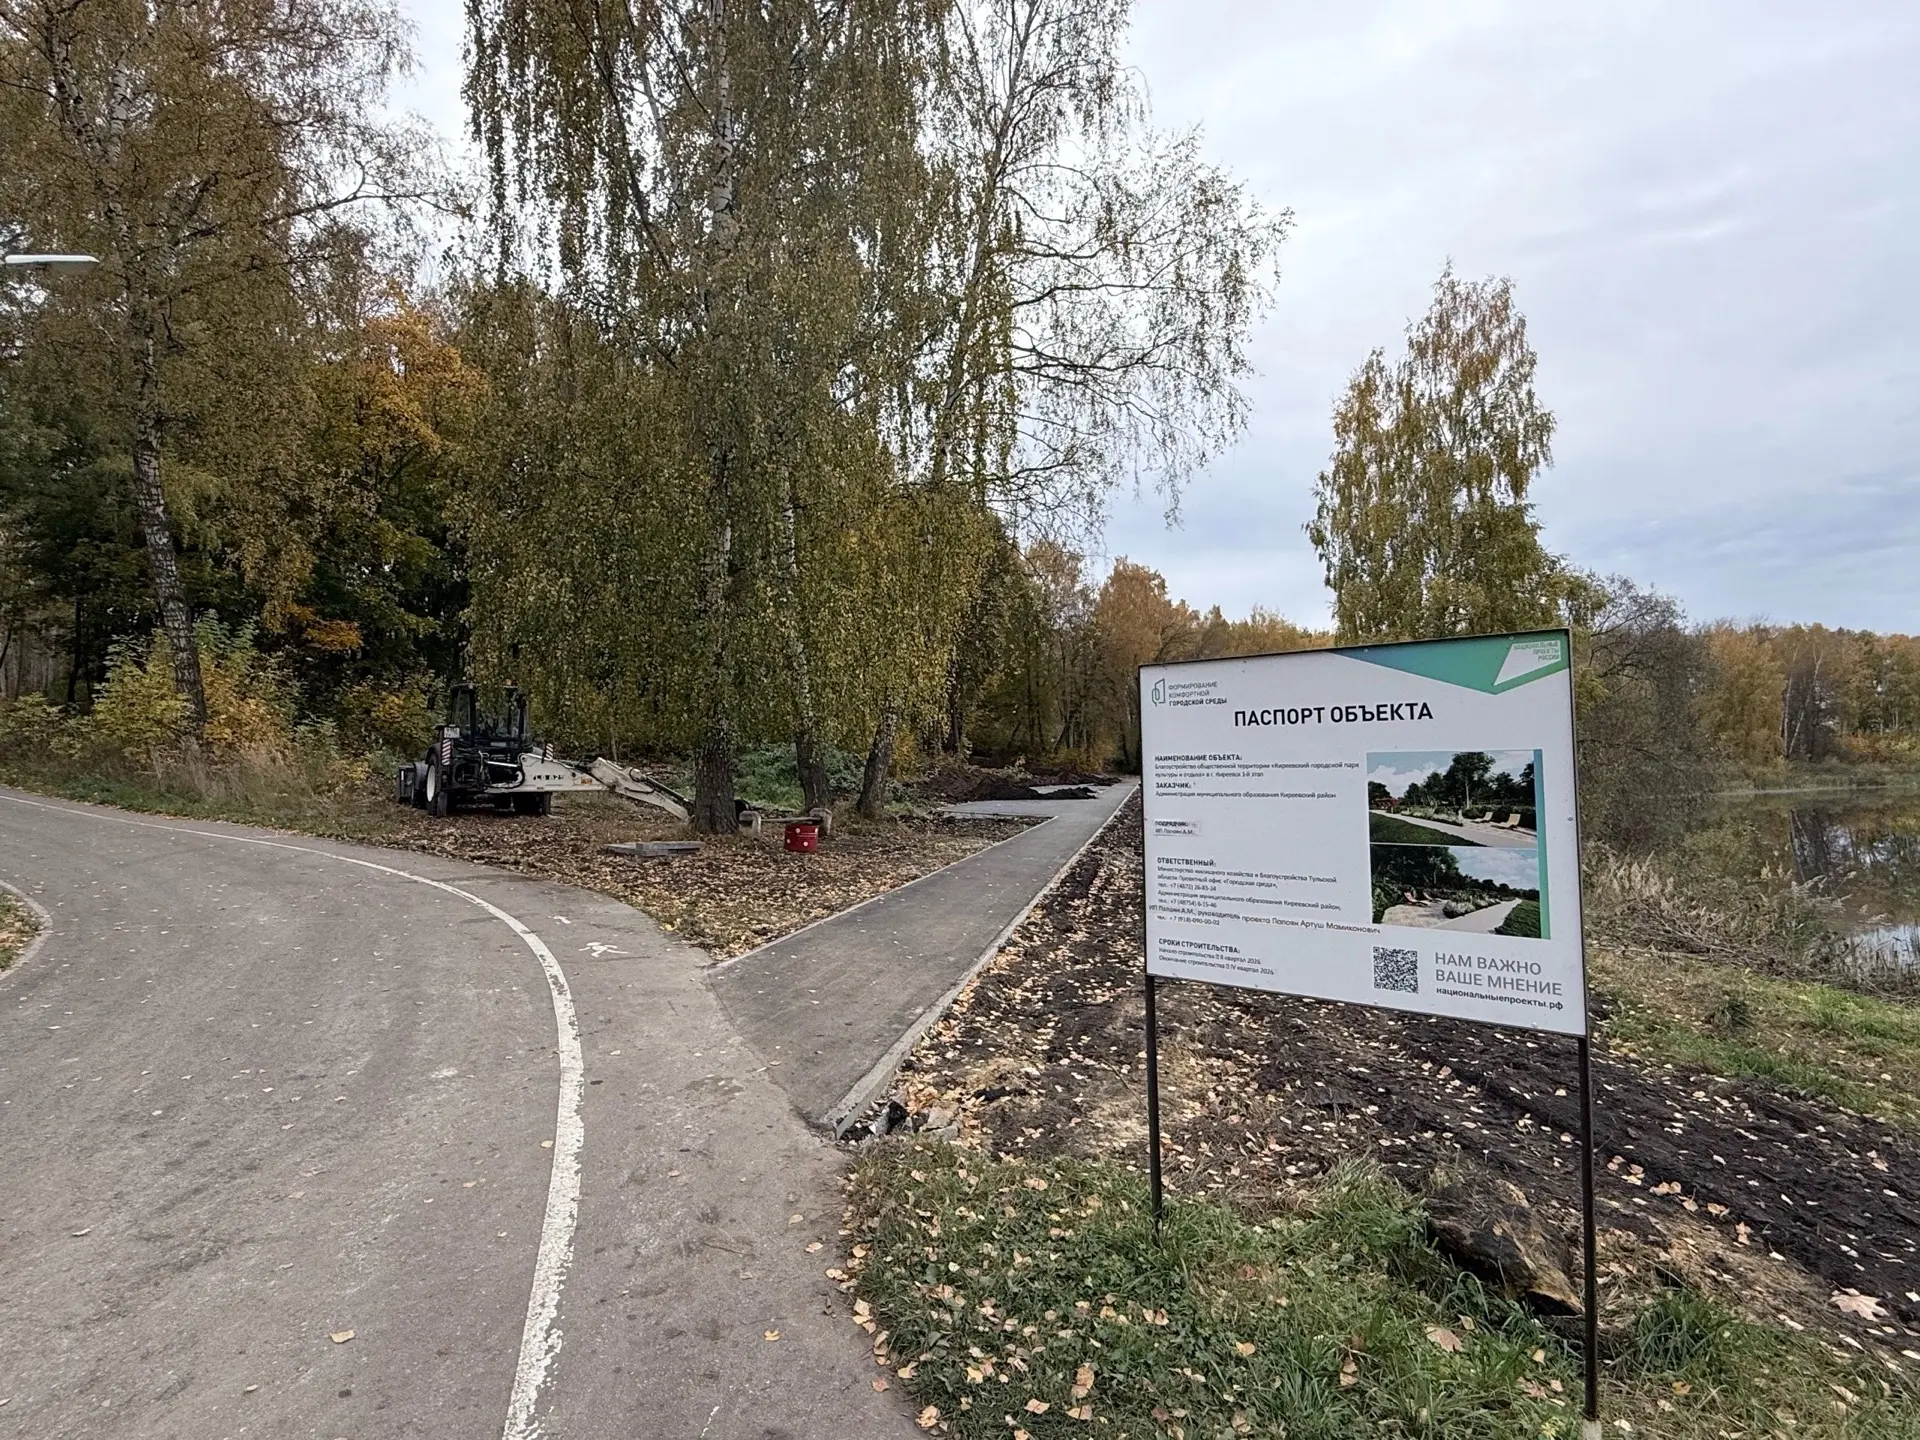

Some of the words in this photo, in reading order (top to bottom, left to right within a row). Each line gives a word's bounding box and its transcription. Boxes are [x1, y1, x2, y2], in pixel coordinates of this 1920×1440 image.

[1168, 682, 1218, 690] ФОРМИРОВАНИЕ
[1168, 690, 1210, 698] КОМФОРТНОЙ
[1169, 698, 1204, 707] ГОРОДСКОЙ
[1234, 706, 1325, 726] ПАСПОРТ
[1330, 702, 1434, 723] ОБЪЕКТА
[1155, 754, 1207, 762] НАИМЕНОВАНИЕ
[1157, 857, 1217, 867] ОТВЕТСТВЕННЫЙ:
[1260, 872, 1308, 881] благоустройства
[1284, 900, 1319, 908] Киреевский
[1242, 915, 1271, 924] проекта
[1272, 917, 1299, 926] Папоян
[1300, 920, 1324, 930] Артуш
[1326, 922, 1381, 934] Мамиконович
[1158, 938, 1180, 946] СРОКИ
[1181, 940, 1240, 954] СТРОИТЕЛЬСТВА:
[1435, 952, 1472, 968] НАМ
[1477, 956, 1542, 976] ВАЖНО
[1436, 969, 1483, 986] ВАШЕ
[1487, 975, 1563, 996] МНЕНИЕ
[1436, 987, 1564, 1011] национальныепроекты.рф
